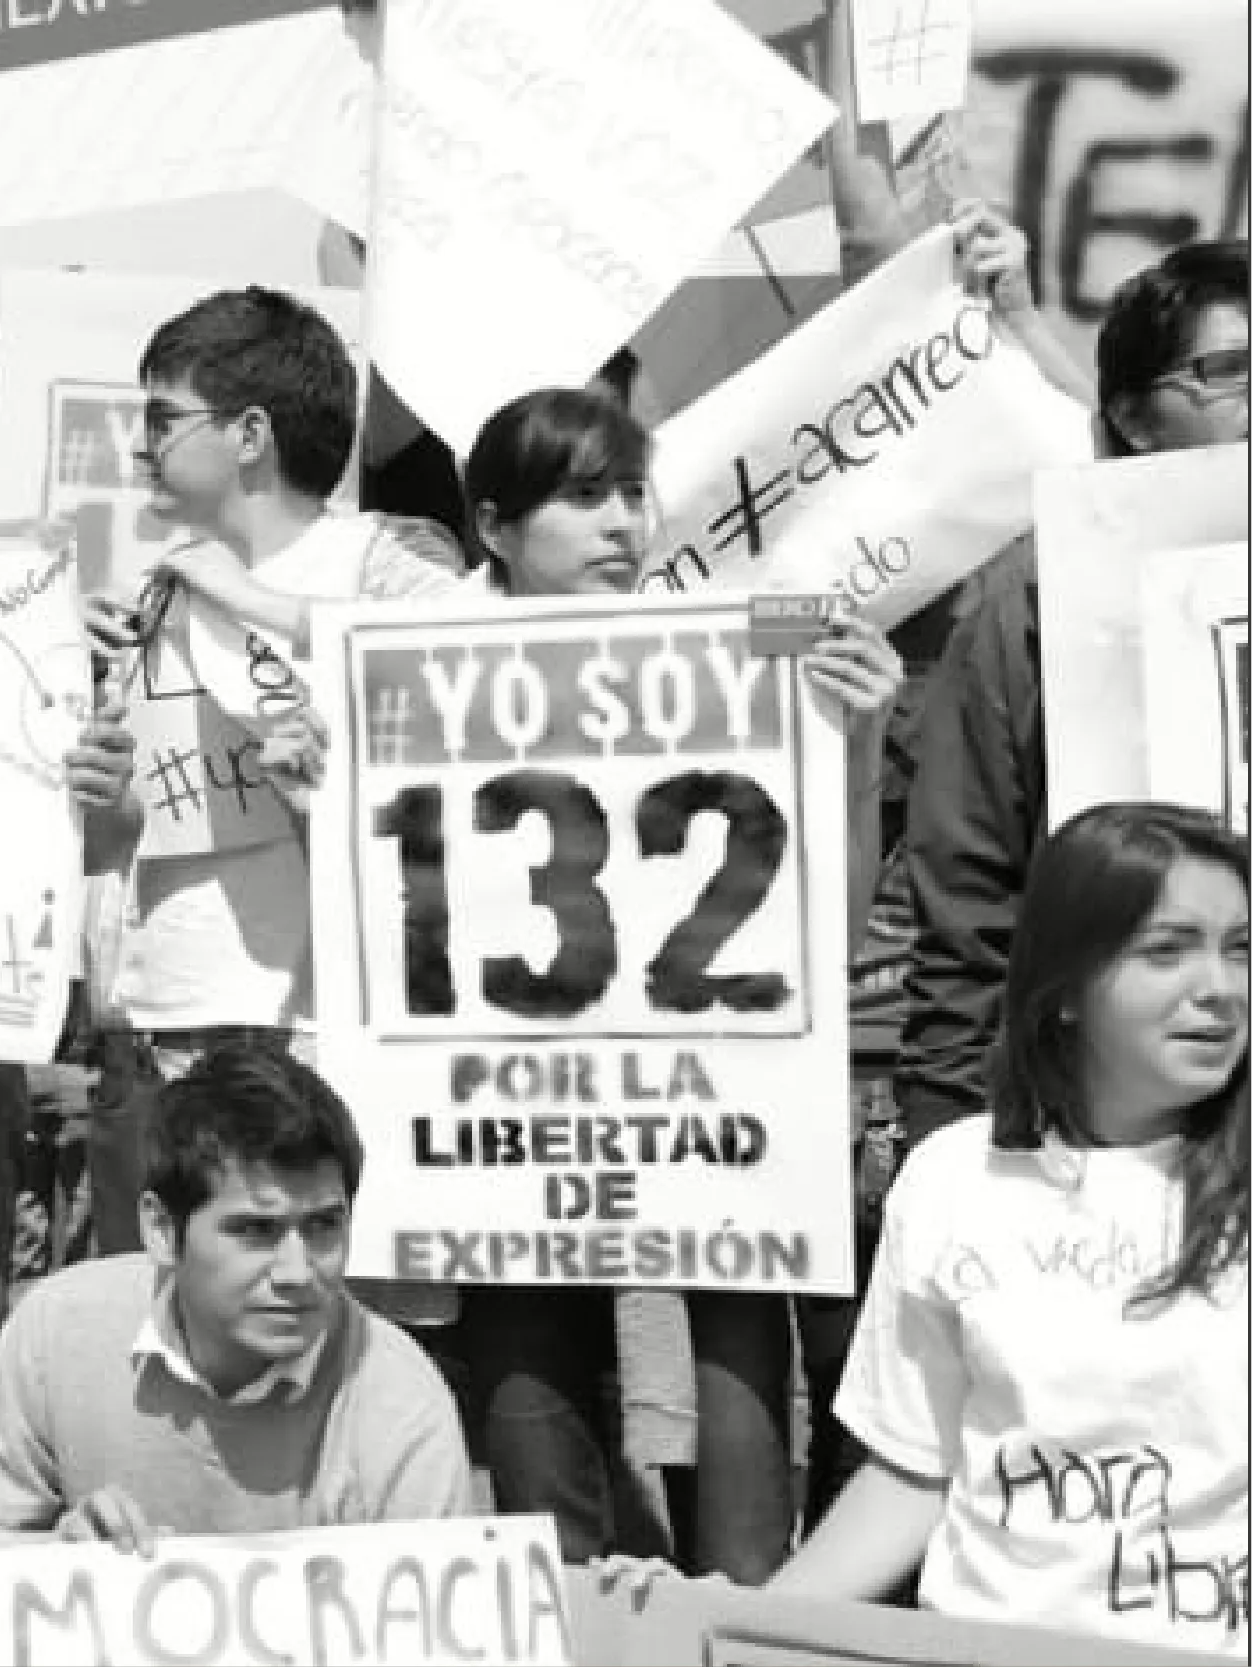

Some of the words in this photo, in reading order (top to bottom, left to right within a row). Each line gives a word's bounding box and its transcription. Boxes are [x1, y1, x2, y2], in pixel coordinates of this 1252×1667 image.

[577, 640, 763, 752] SOY
[372, 768, 795, 1020] 132
[449, 1052, 601, 1103] POR
[619, 1050, 716, 1102] LA
[411, 1113, 768, 1168] LIBERTAD
[543, 1170, 637, 1220] DE
[391, 1217, 811, 1281] EXPRESIÓN
